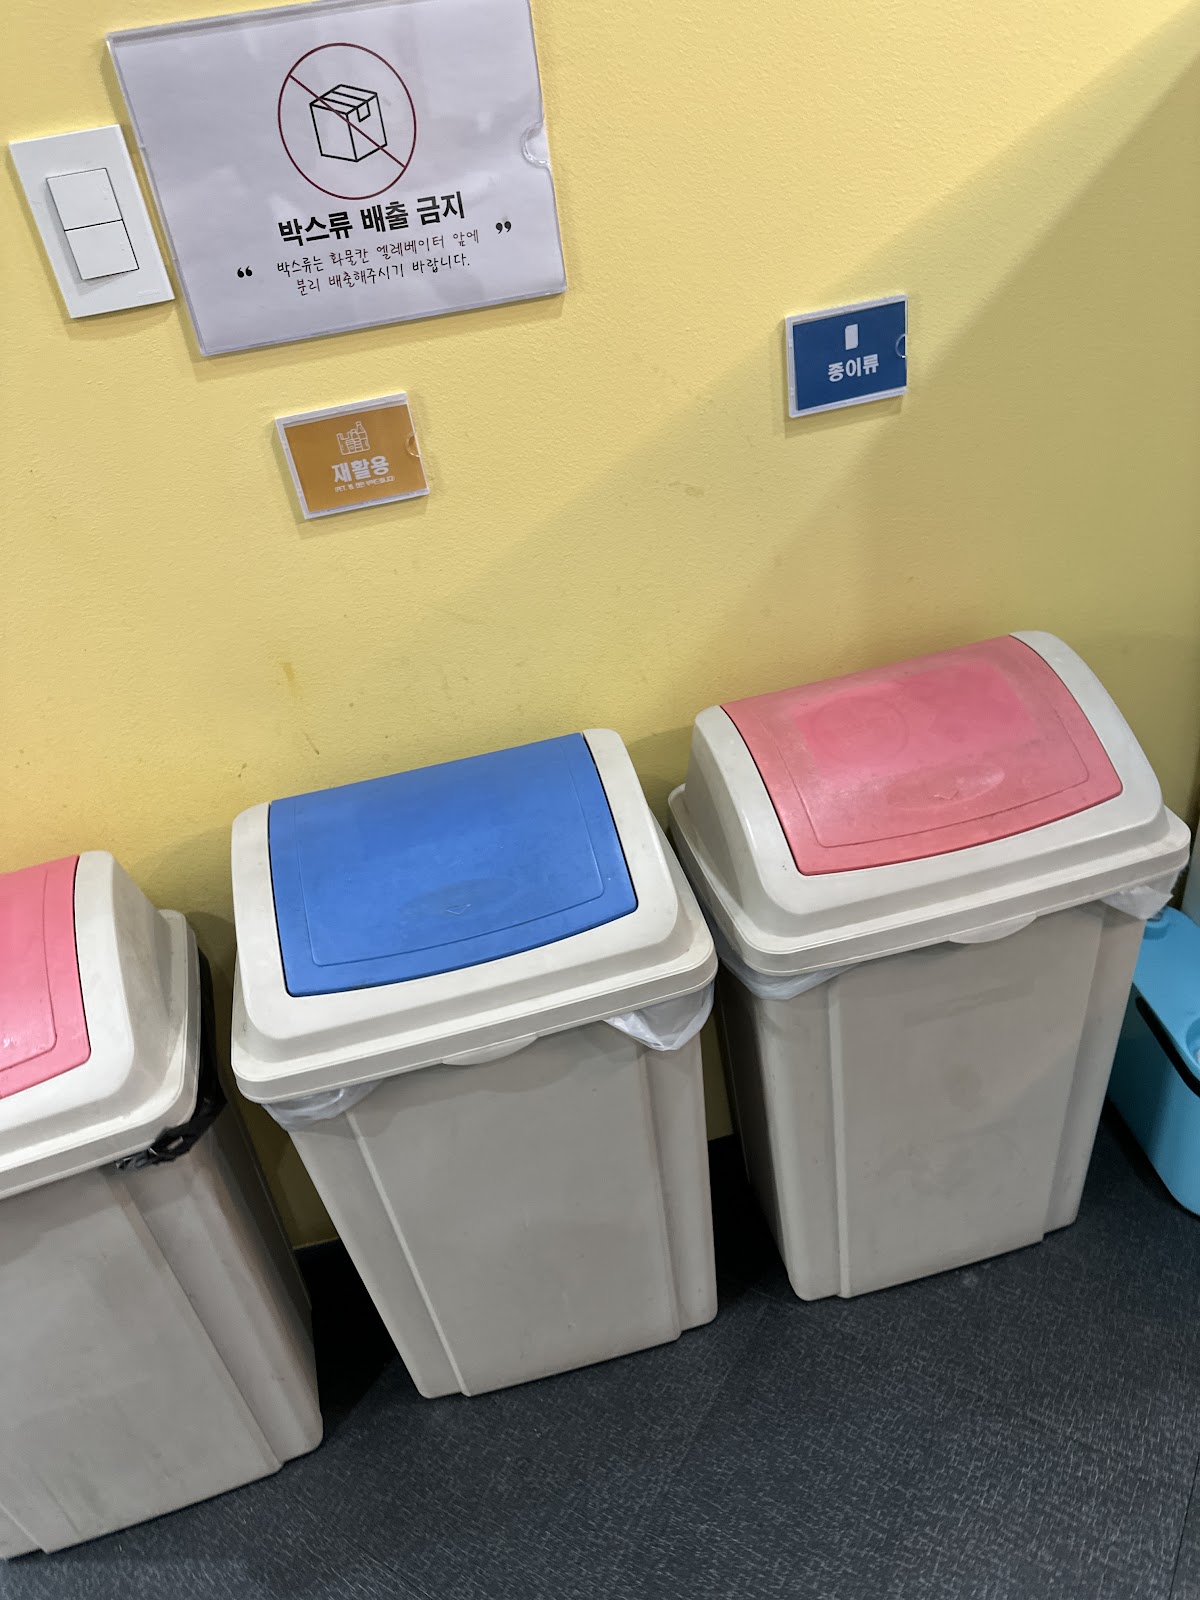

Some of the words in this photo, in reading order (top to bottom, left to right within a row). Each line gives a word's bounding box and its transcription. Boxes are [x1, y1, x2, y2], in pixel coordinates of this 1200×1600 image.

[278, 211, 353, 247] 박스류
[360, 201, 409, 233] 배출
[416, 191, 466, 225] 금지
[276, 254, 324, 278] 박스류는
[330, 248, 369, 267] 화물칸
[376, 236, 445, 260] 엘레베이터
[453, 229, 480, 247] 앞에
[296, 278, 321, 296] 분리
[328, 262, 404, 289] 배출해주시기
[412, 252, 470, 273] 바랍니다.
[828, 354, 879, 382] 종이류
[331, 455, 389, 483] 재활용
